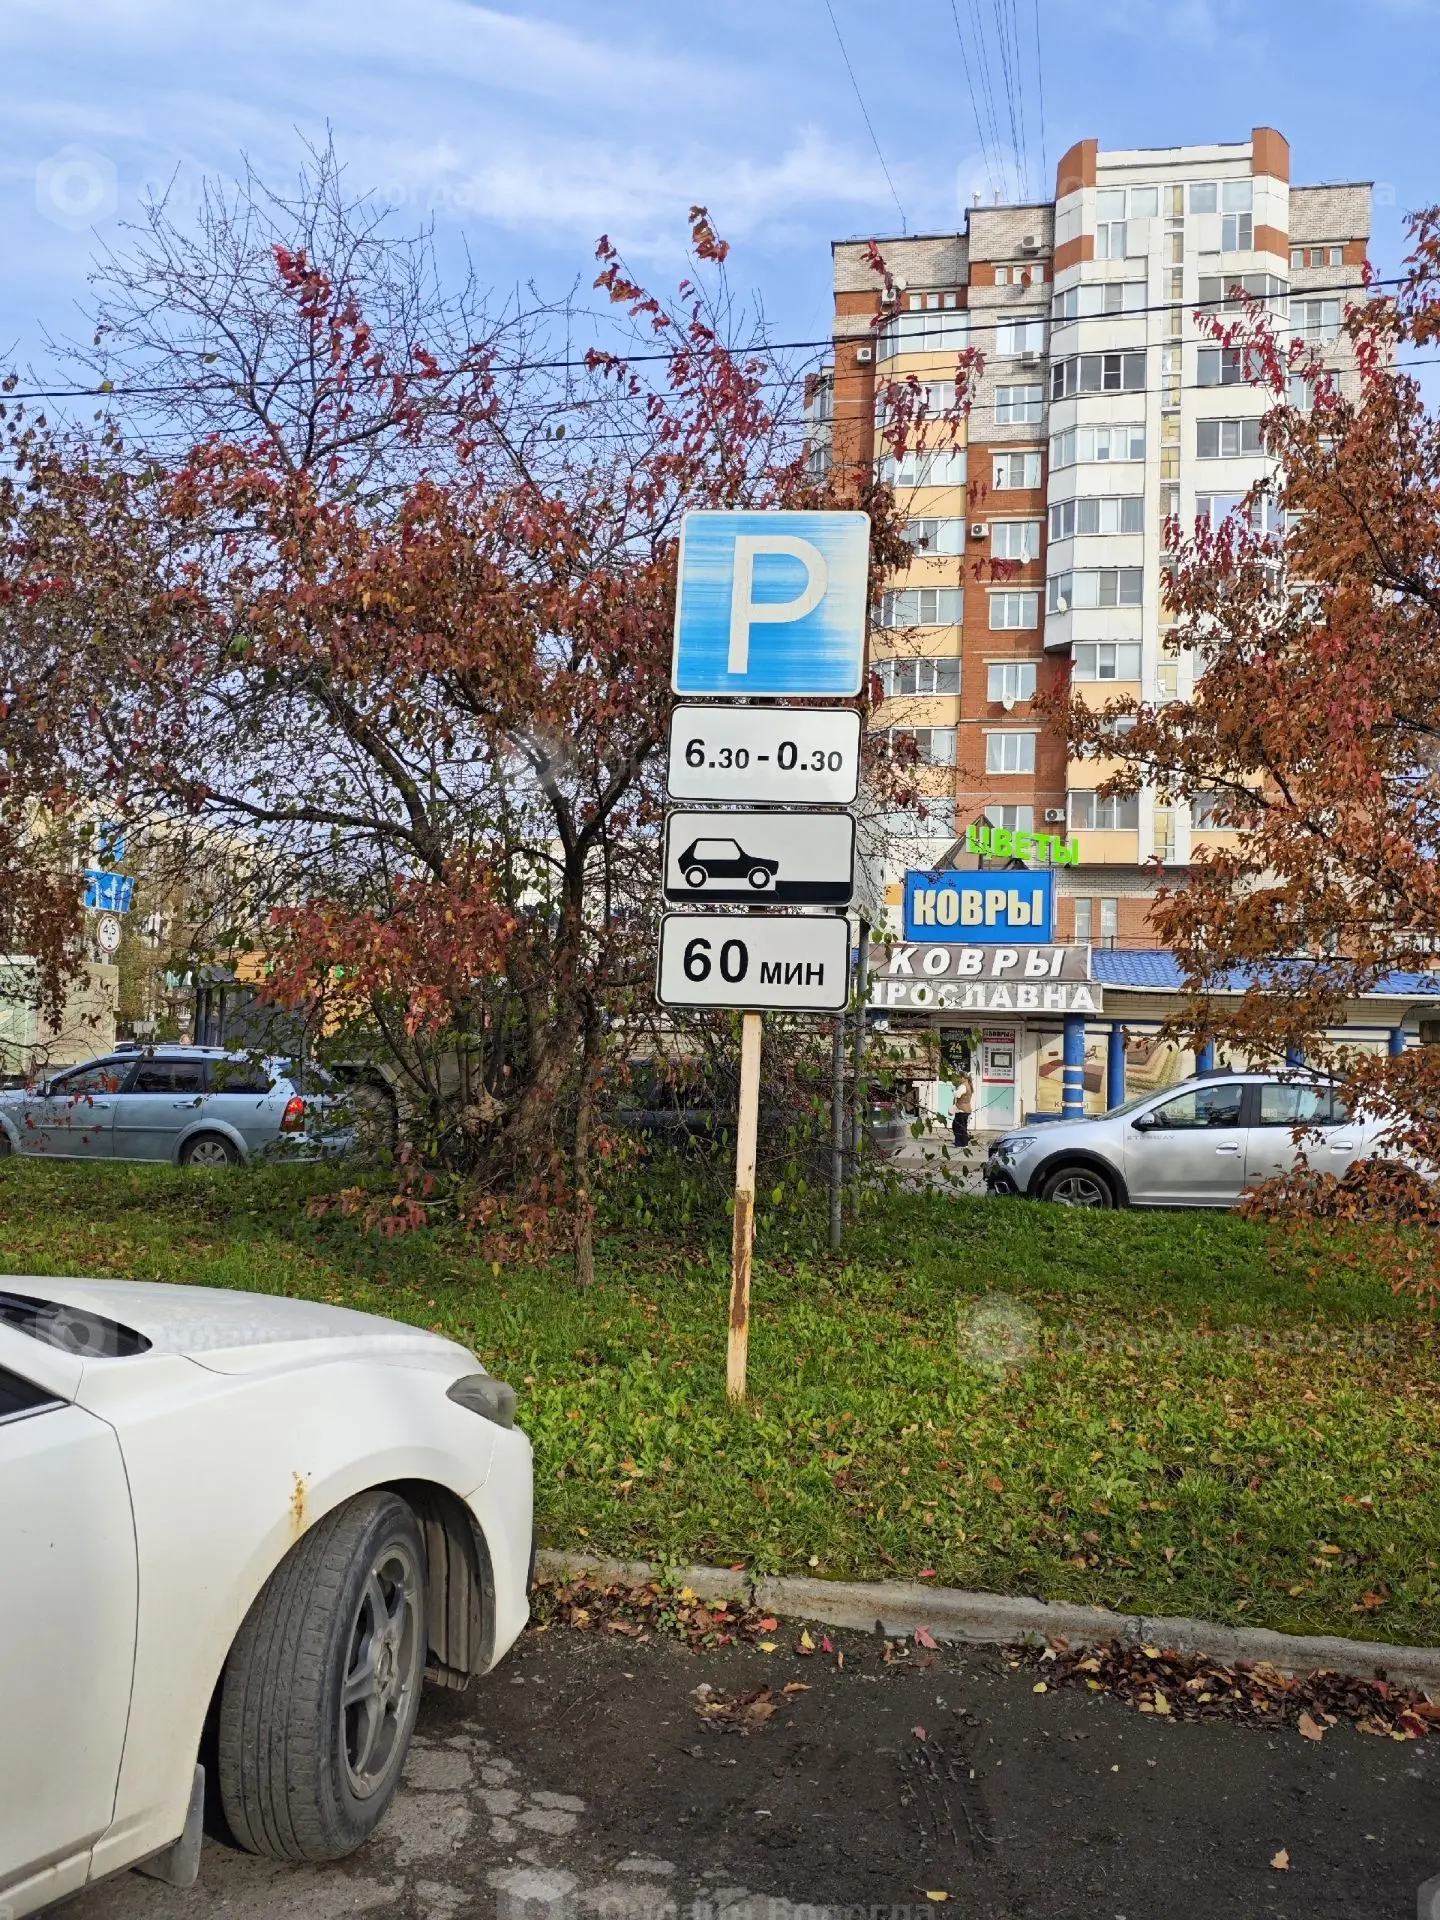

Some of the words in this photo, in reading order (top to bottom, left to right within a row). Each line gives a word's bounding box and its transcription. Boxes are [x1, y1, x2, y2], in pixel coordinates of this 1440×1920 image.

[727, 534, 828, 675] P
[965, 824, 1080, 866] ЦВЕТЫ
[912, 888, 1044, 926] КОВРЫ
[683, 937, 749, 983] 60
[888, 947, 1067, 977] КОВРЫ
